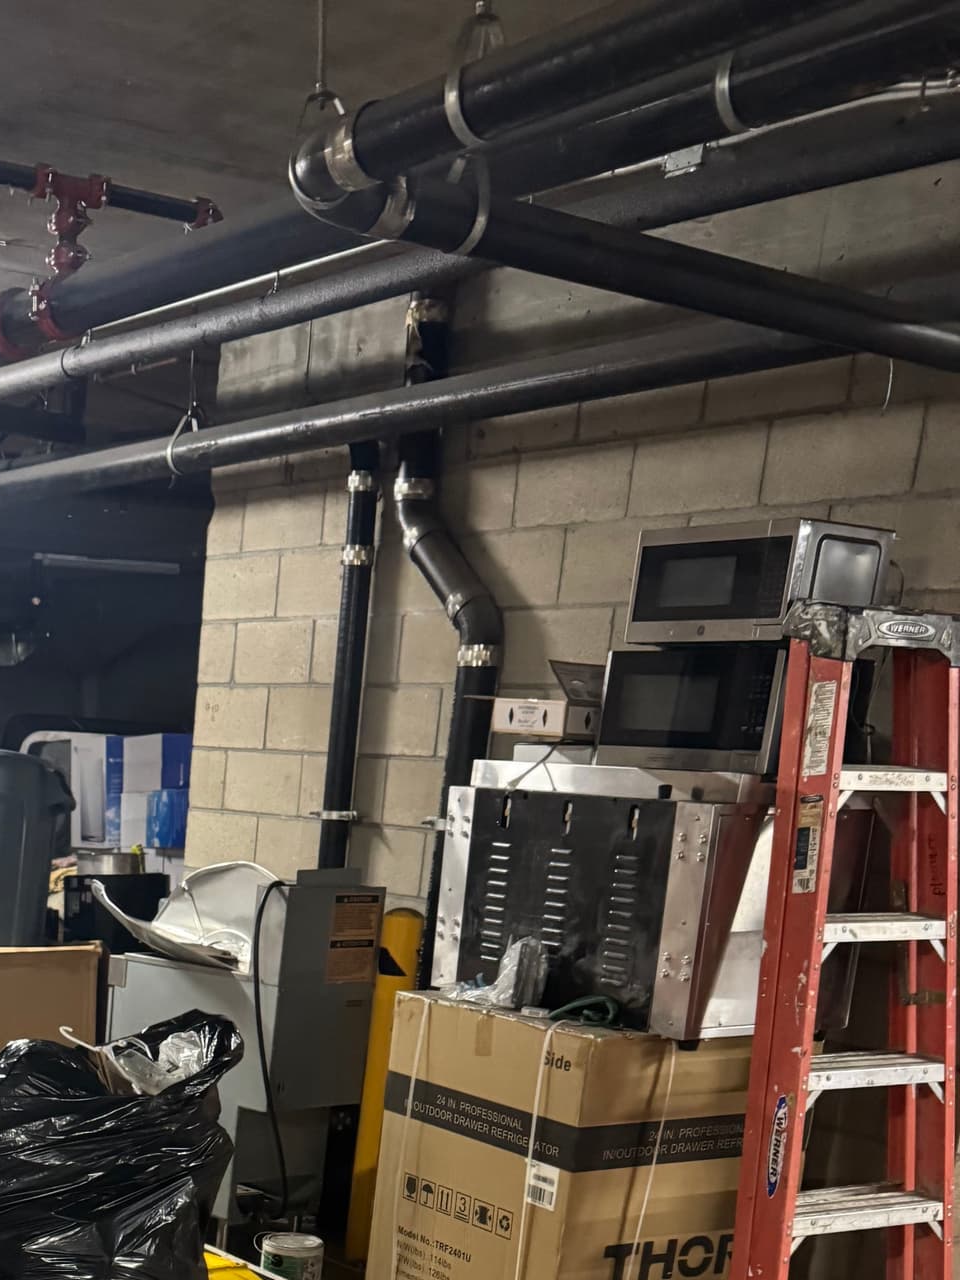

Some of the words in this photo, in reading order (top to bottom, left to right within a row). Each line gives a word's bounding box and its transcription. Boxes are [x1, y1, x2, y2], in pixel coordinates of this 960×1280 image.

[890, 624, 926, 633] WERNER
[544, 1051, 572, 1072] Side
[436, 1094, 446, 1105] 24
[459, 1101, 524, 1131] PROFESSIONAL
[453, 1113, 490, 1135] DRAWER
[491, 1126, 559, 1157] REFRIGEATOR
[602, 1144, 668, 1161] IN/OUTDOR
[670, 1139, 714, 1155] DRAWER
[770, 1116, 783, 1178] WERNER
[398, 1225, 419, 1241] Model
